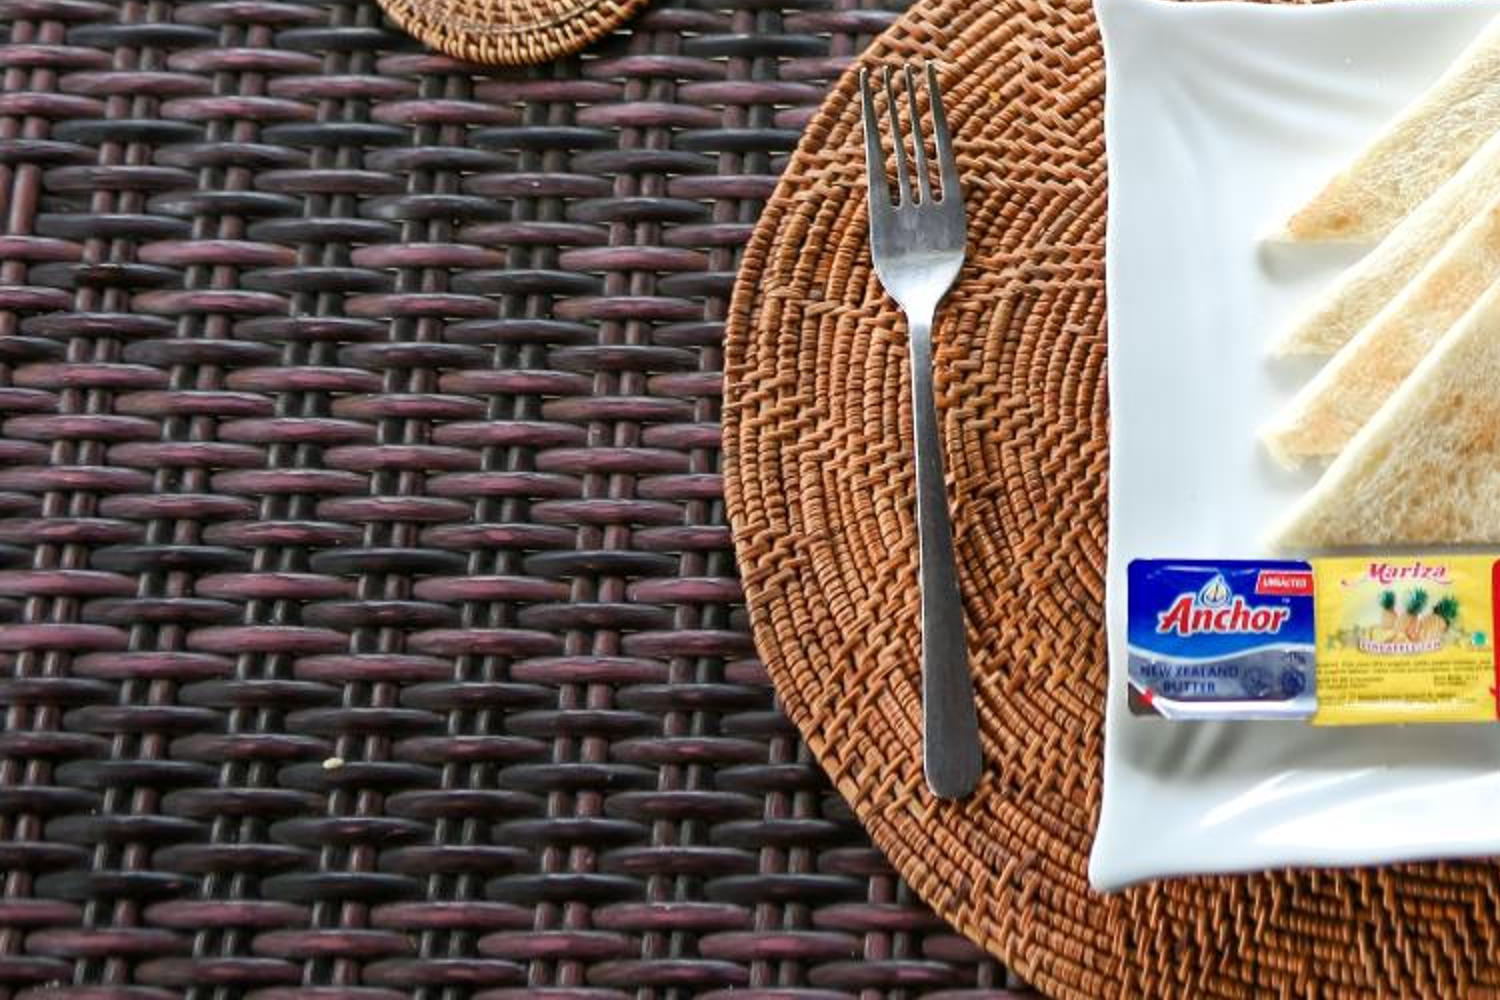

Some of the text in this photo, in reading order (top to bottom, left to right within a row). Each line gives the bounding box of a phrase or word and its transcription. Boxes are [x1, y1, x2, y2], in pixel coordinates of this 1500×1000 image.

[1157, 593, 1290, 636] Anchor
[1140, 665, 1240, 678] NEW ZEALAND
[1163, 680, 1216, 693] BUTTER
